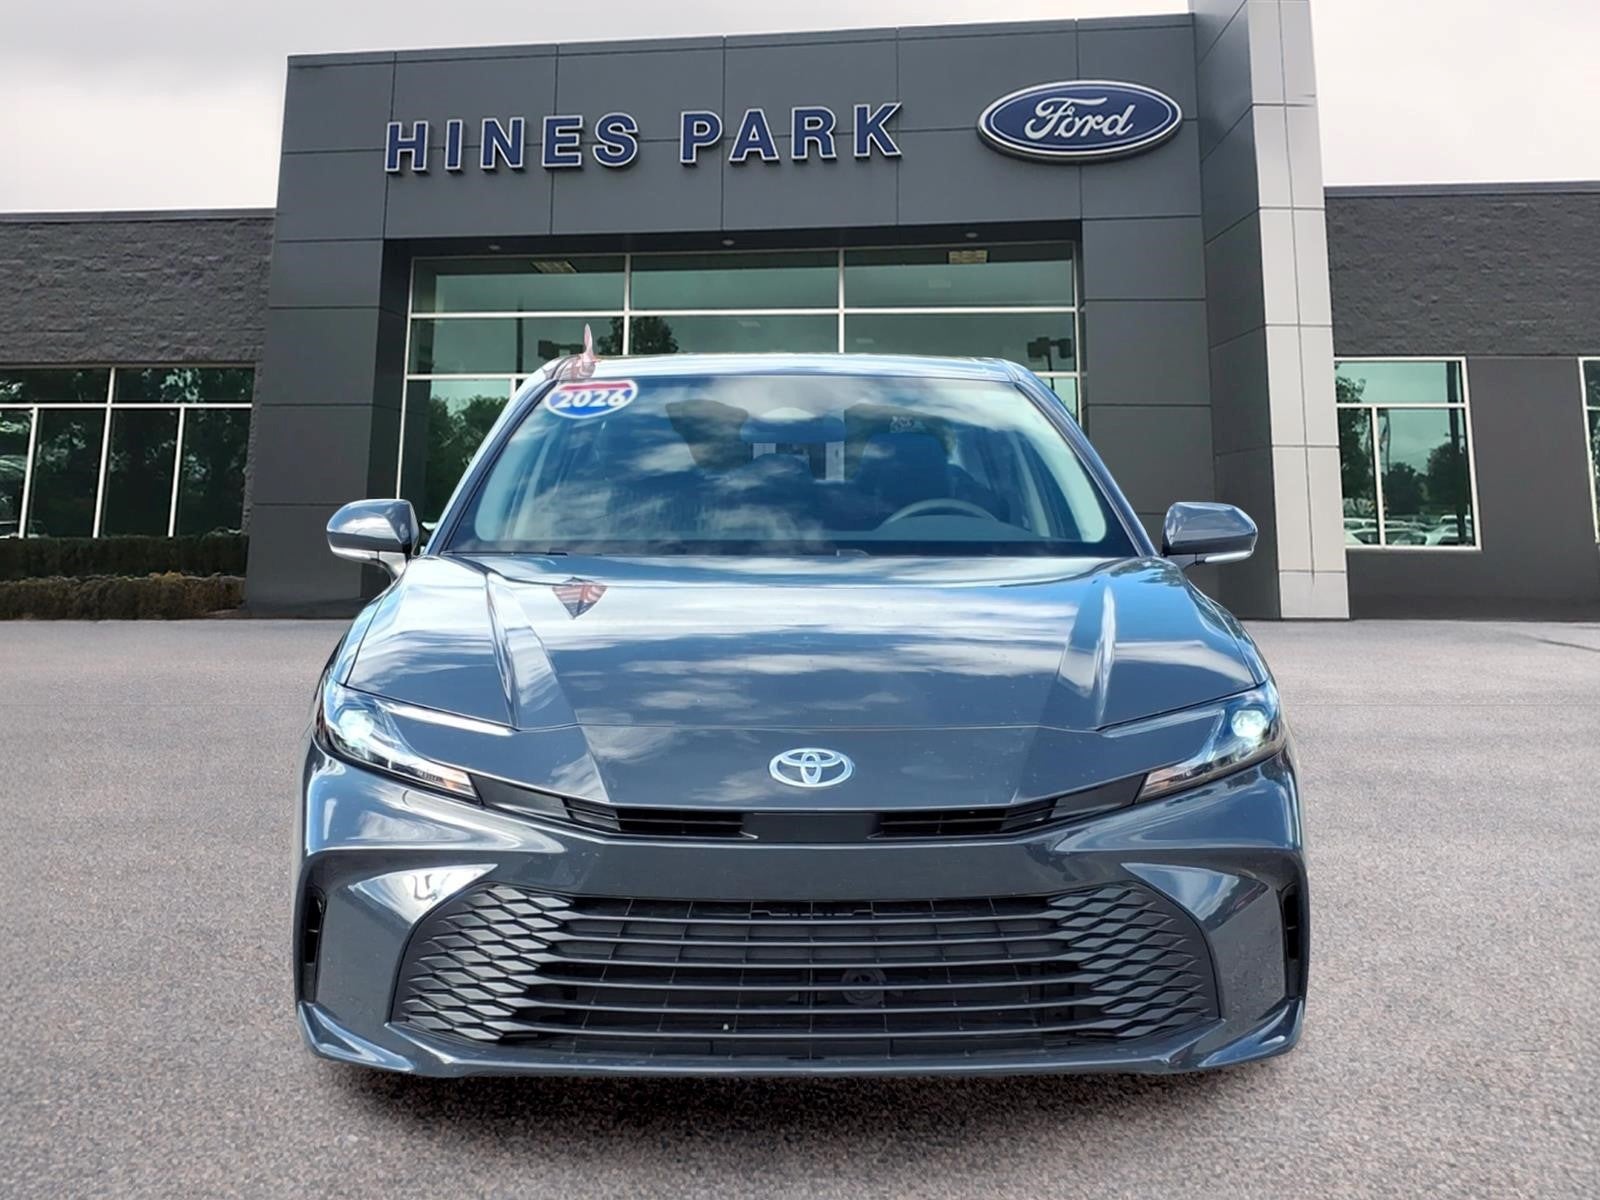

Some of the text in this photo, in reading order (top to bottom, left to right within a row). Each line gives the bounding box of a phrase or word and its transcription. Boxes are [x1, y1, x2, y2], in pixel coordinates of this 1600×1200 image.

[384, 102, 903, 172] HINES PARK
[1024, 97, 1136, 139] Ford
[553, 390, 626, 408] 2026
